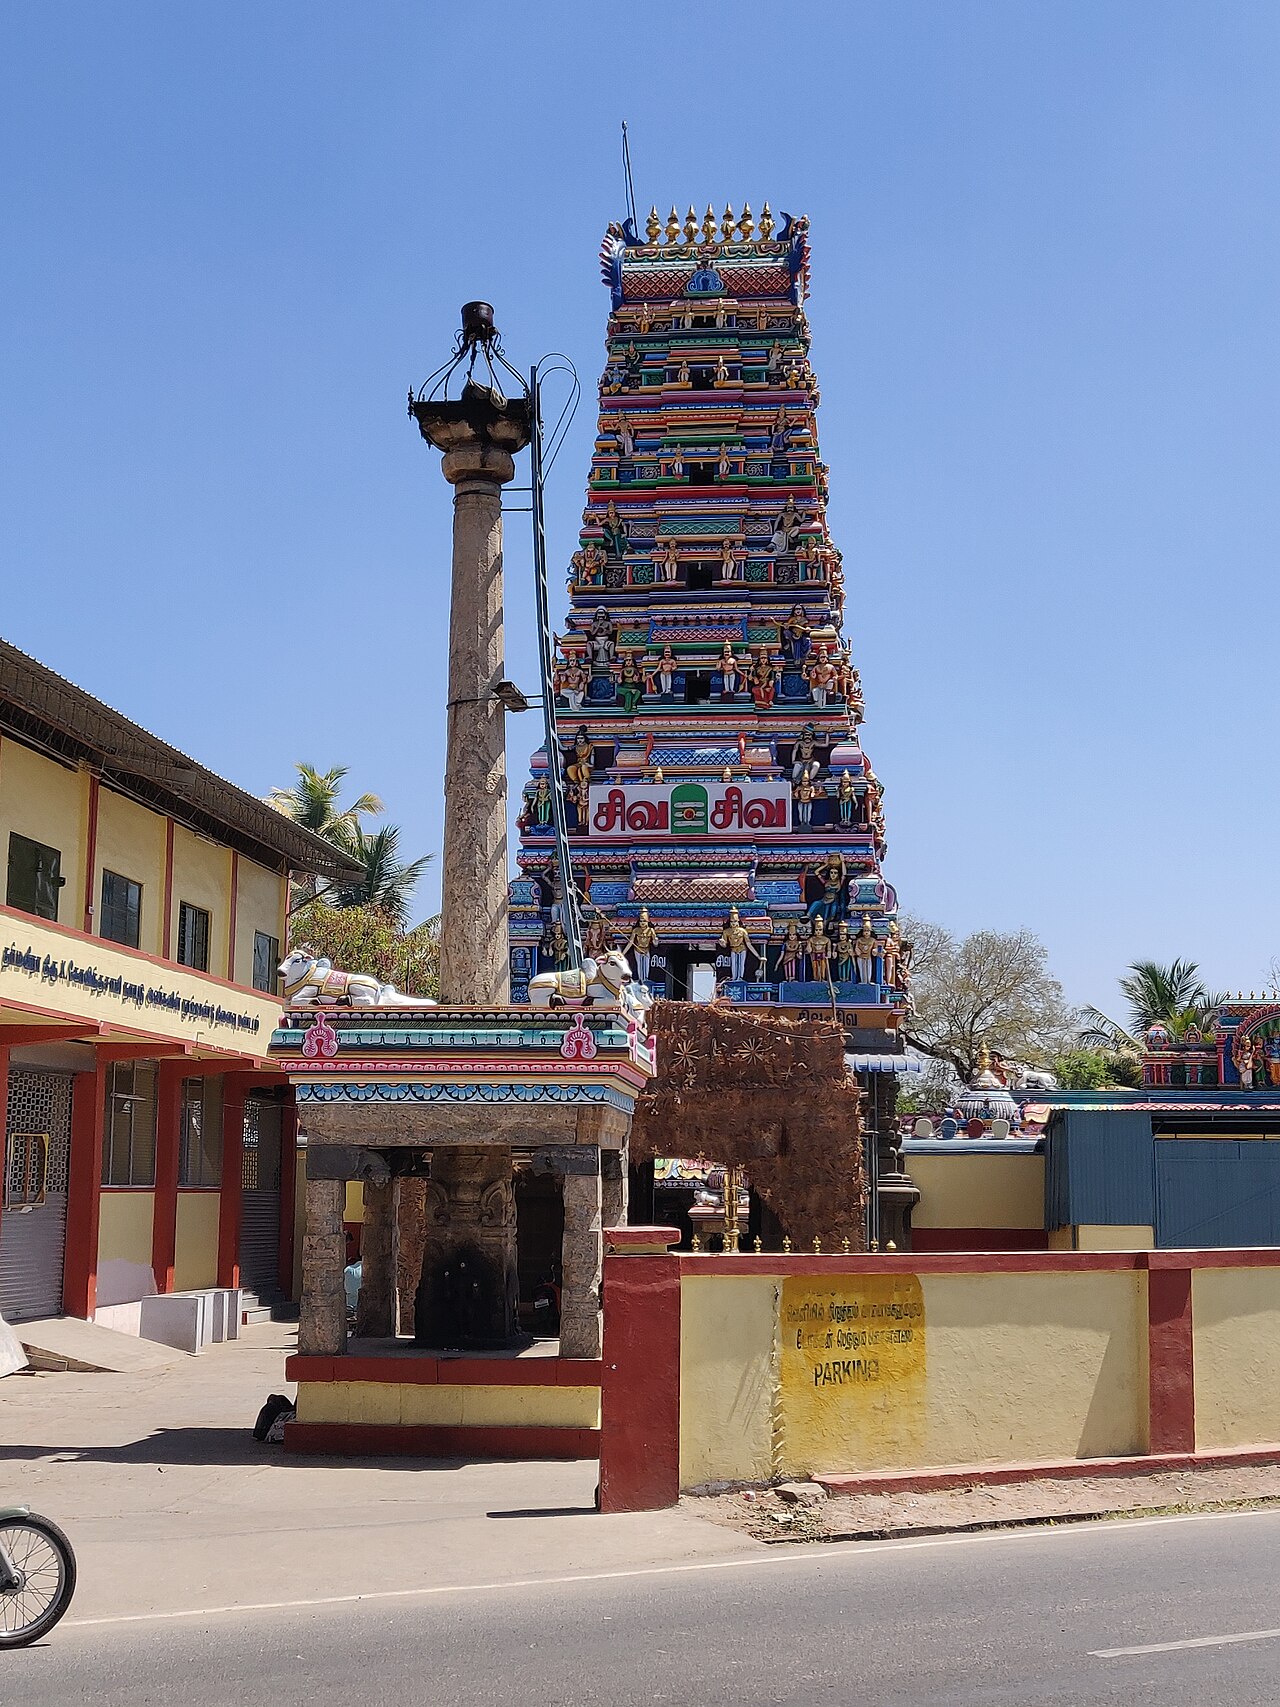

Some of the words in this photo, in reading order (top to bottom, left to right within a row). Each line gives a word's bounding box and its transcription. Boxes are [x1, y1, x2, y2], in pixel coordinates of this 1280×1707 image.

[593, 788, 669, 832] சிவ
[710, 786, 787, 829] சிவ
[650, 954, 667, 967] சிவ
